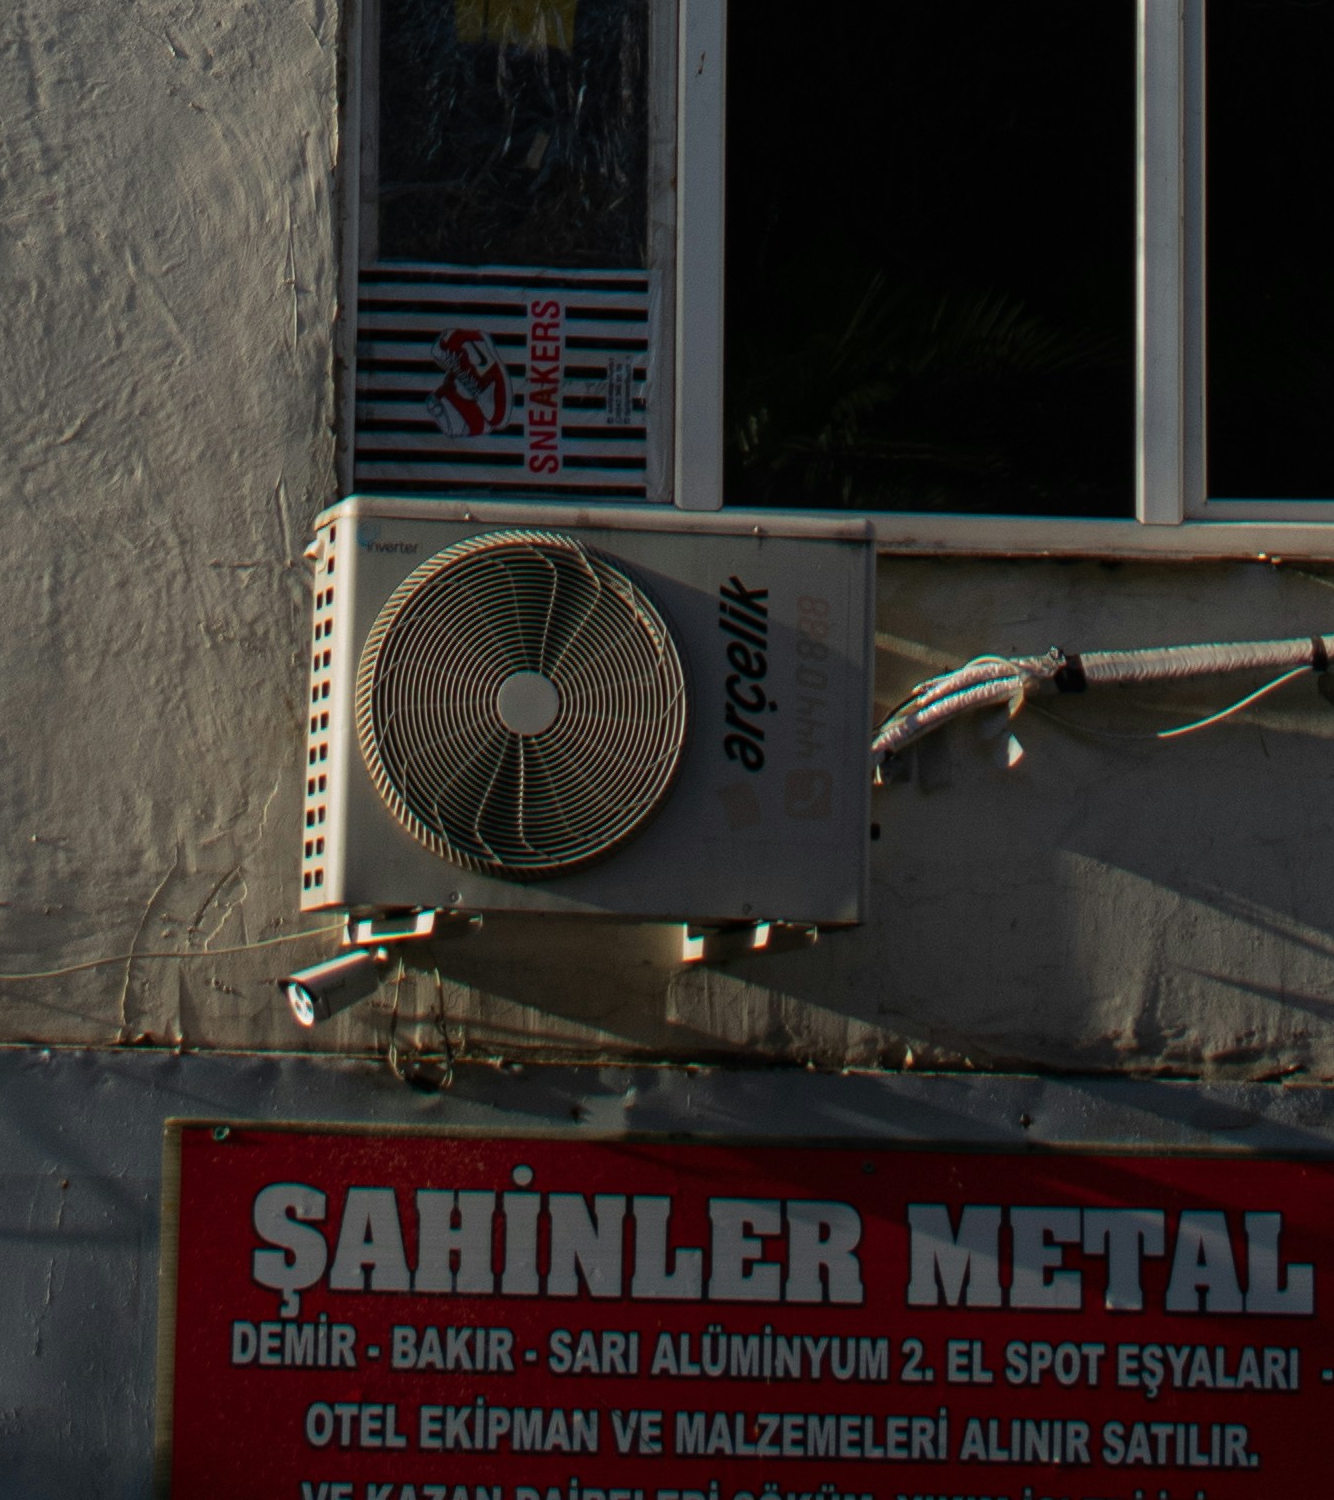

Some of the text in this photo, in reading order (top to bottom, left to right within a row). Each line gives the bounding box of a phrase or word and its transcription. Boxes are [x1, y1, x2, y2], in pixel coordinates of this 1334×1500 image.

[529, 301, 562, 474] SNEAKERS
[719, 575, 778, 773] arçelik
[252, 1165, 1315, 1316] ŞAHİNLER METAL
[231, 1313, 357, 1369] DEMİR
[392, 1324, 515, 1372] BAKIR
[548, 1330, 639, 1375] SARI
[651, 1324, 889, 1381] ALÜMİNYUM
[901, 1337, 934, 1381] 2.
[947, 1339, 992, 1384] EL
[1005, 1341, 1105, 1386] SPOT
[1117, 1344, 1299, 1398] EŞYALARI
[304, 1396, 1261, 1467] OTEL EKİPMAN VE MALZEMELERİ ALINIR SATILIR.
